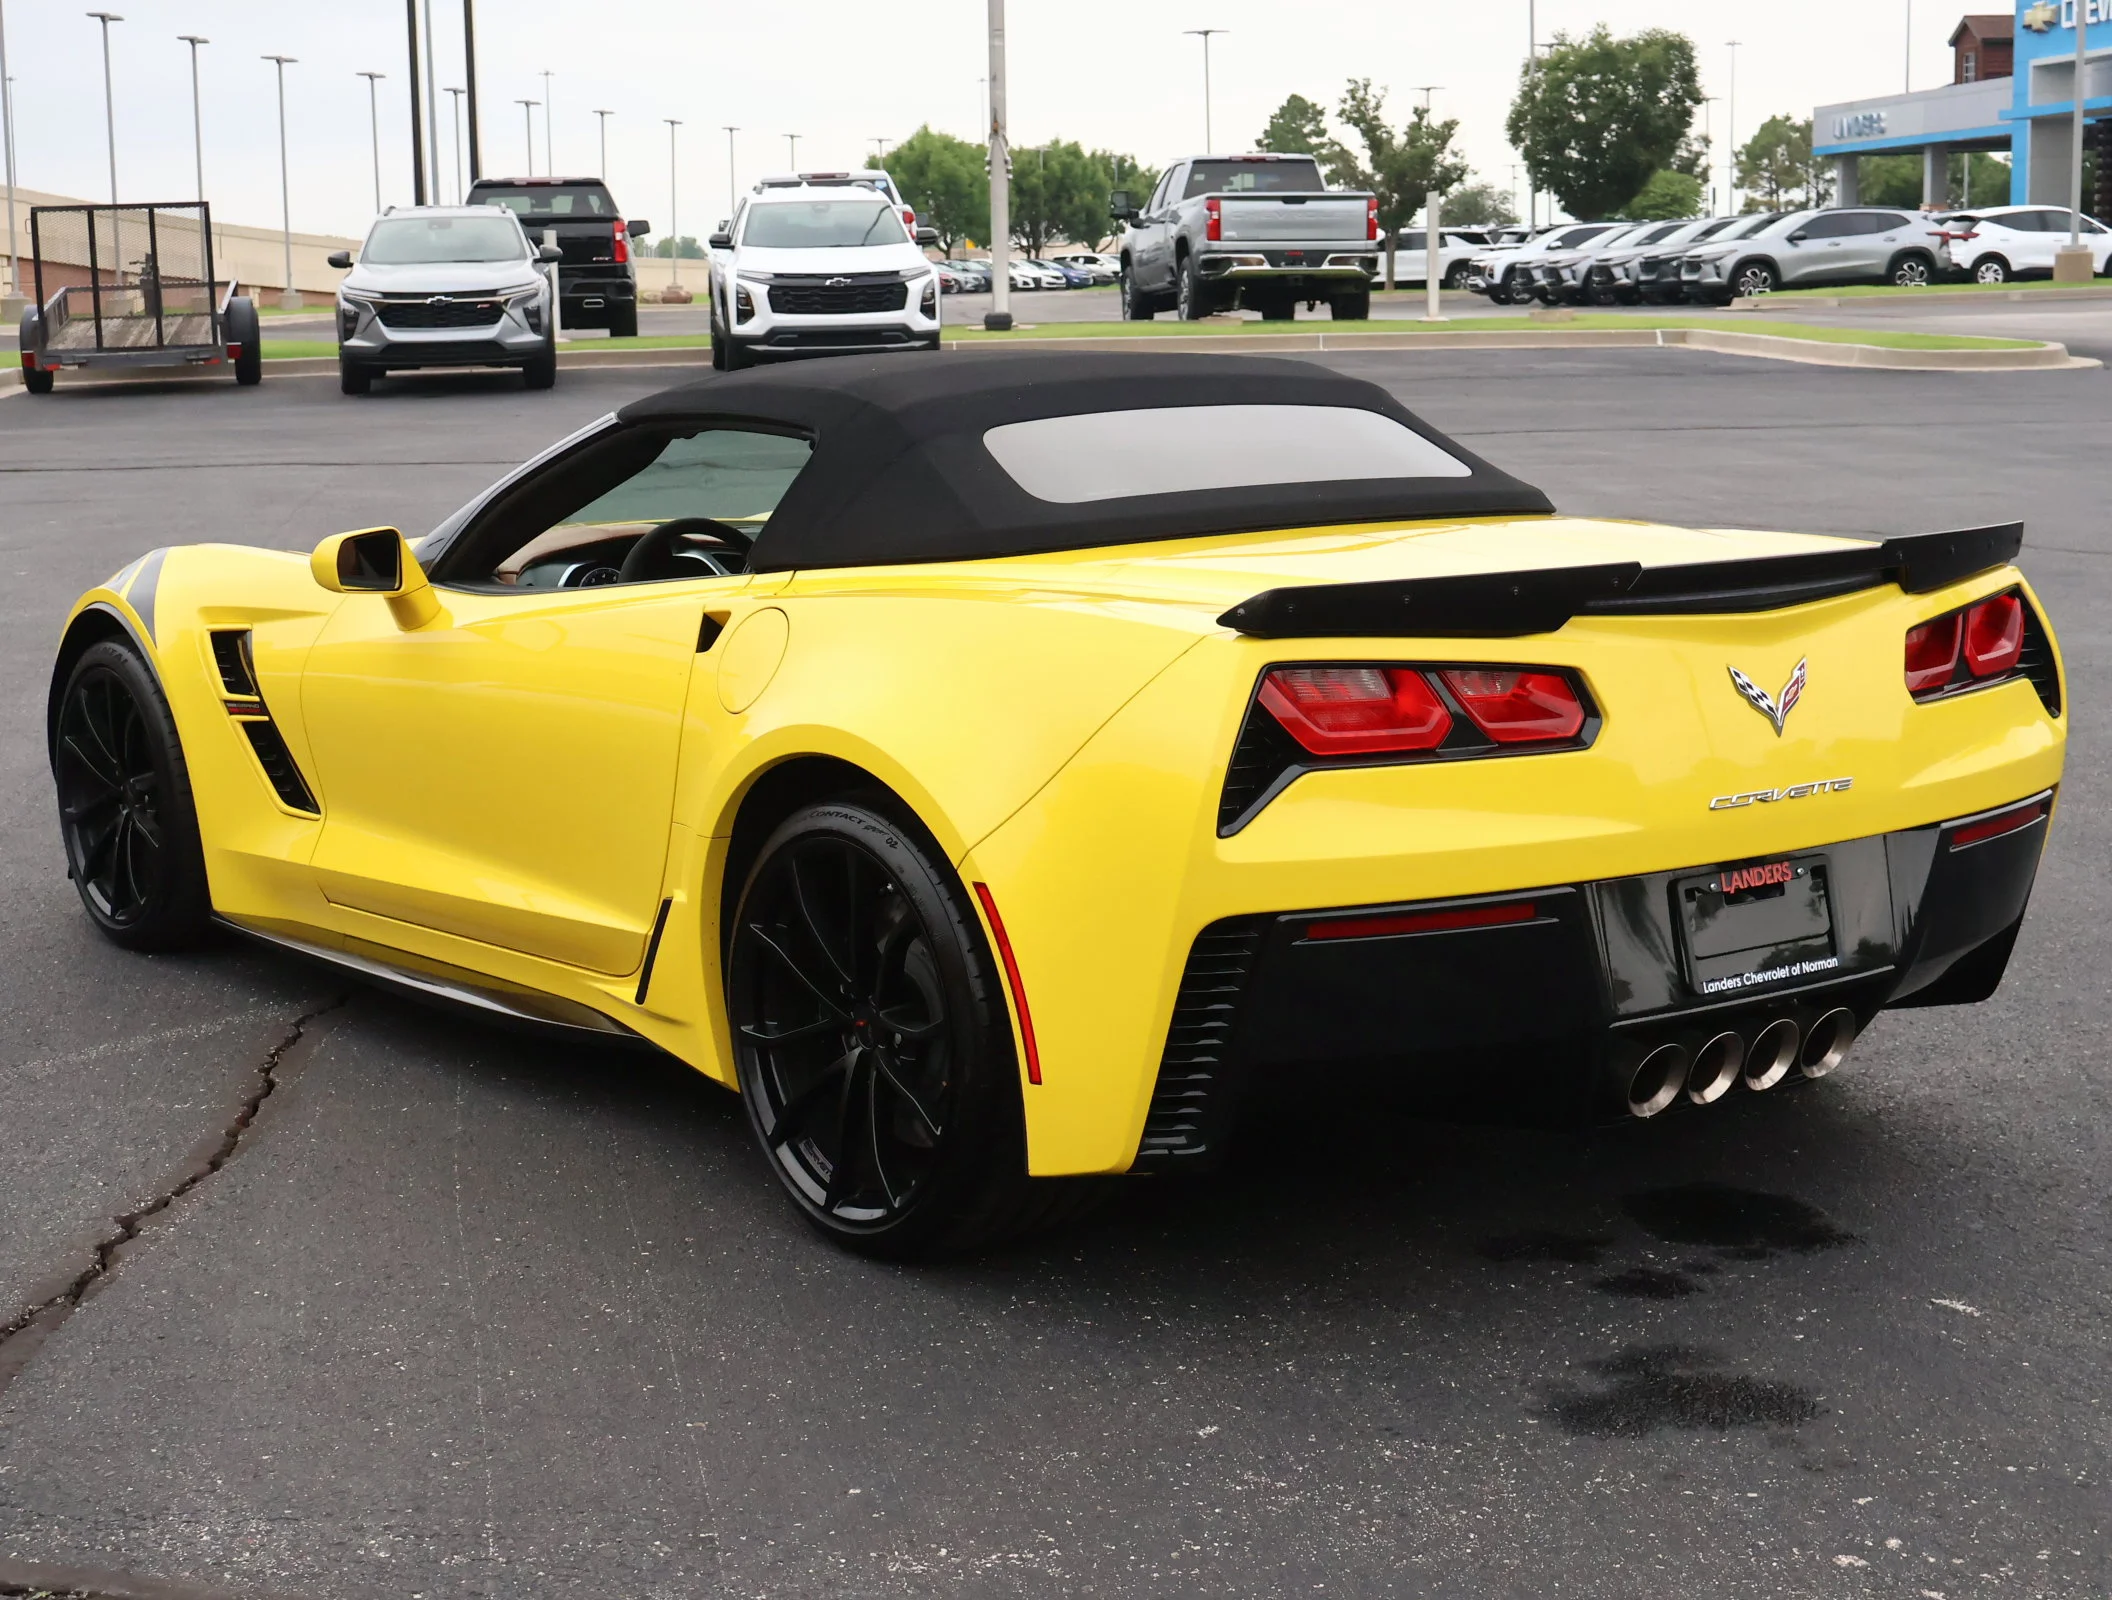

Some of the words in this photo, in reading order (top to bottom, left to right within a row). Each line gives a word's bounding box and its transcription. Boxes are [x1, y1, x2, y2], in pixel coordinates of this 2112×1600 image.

[1710, 777, 1853, 810] CORVETTE
[809, 811, 866, 824] CONTACT
[1720, 861, 1792, 894] LANDERS
[1703, 978, 1742, 994] Landers
[1743, 965, 1790, 986] Chevrolet
[1791, 963, 1801, 975] of
[1802, 957, 1839, 973] Norman
